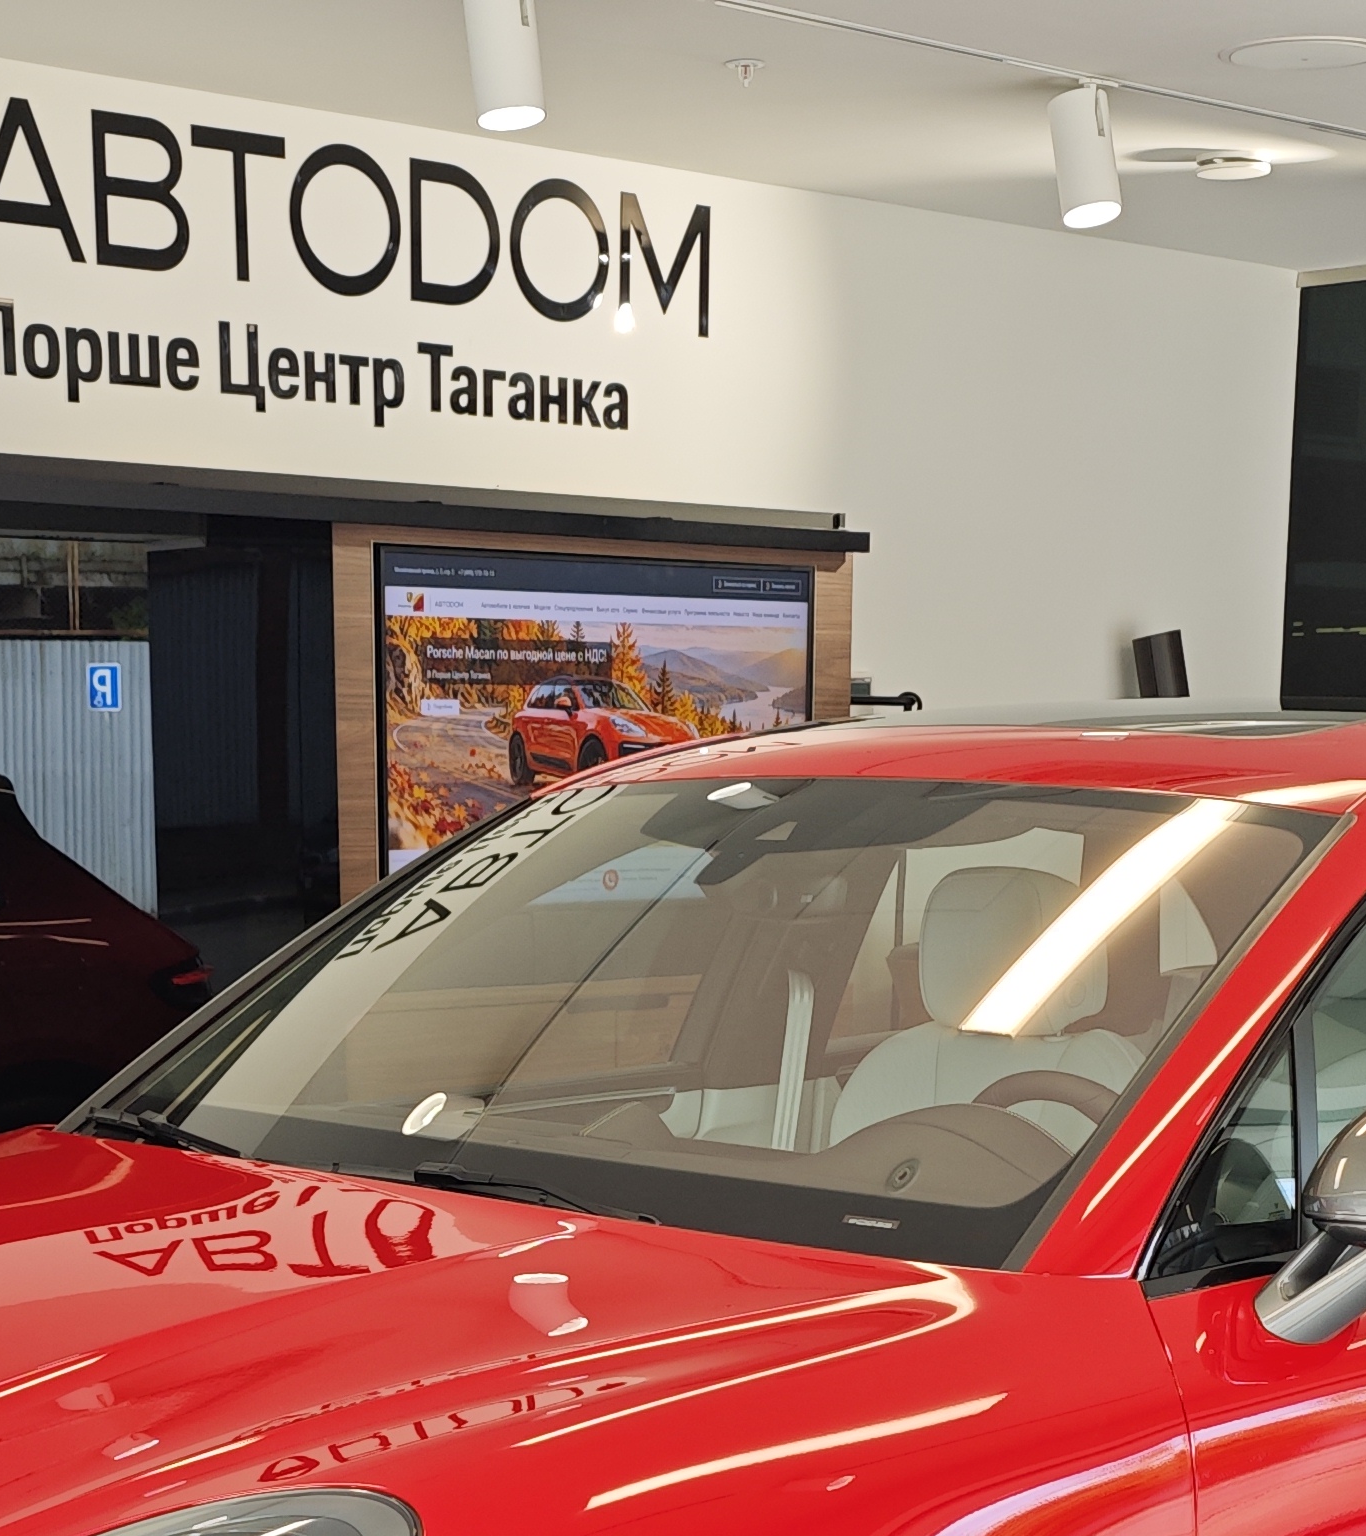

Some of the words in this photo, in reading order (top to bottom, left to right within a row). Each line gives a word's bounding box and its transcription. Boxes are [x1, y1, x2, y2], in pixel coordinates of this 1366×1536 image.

[219, 320, 405, 427] Центр
[417, 342, 630, 430] Таганка
[427, 645, 463, 660] Porsche
[465, 646, 496, 660] Macan
[497, 650, 508, 660] по
[510, 649, 553, 663] выгодной
[555, 651, 576, 663] цене
